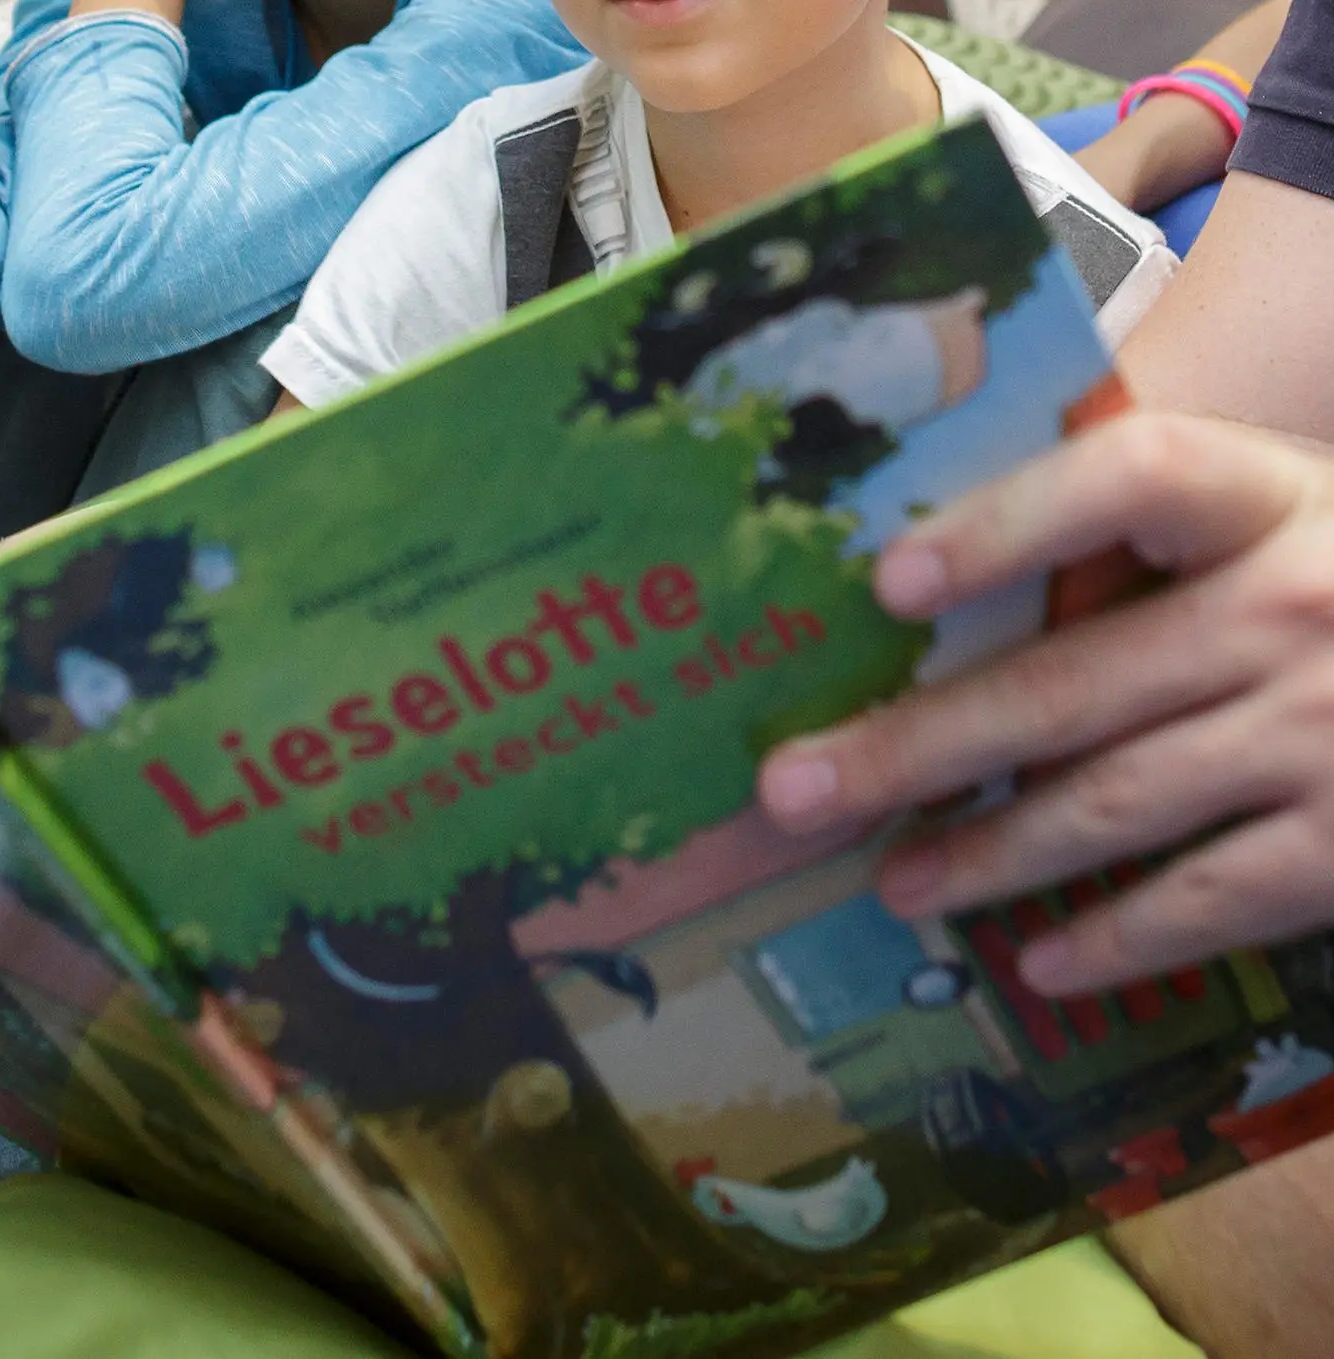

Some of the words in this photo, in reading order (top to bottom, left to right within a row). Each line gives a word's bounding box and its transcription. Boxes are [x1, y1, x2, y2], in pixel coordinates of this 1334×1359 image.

[142, 563, 702, 838] Lieselotte
[300, 680, 656, 854] versteckt
[673, 603, 827, 699] sich
